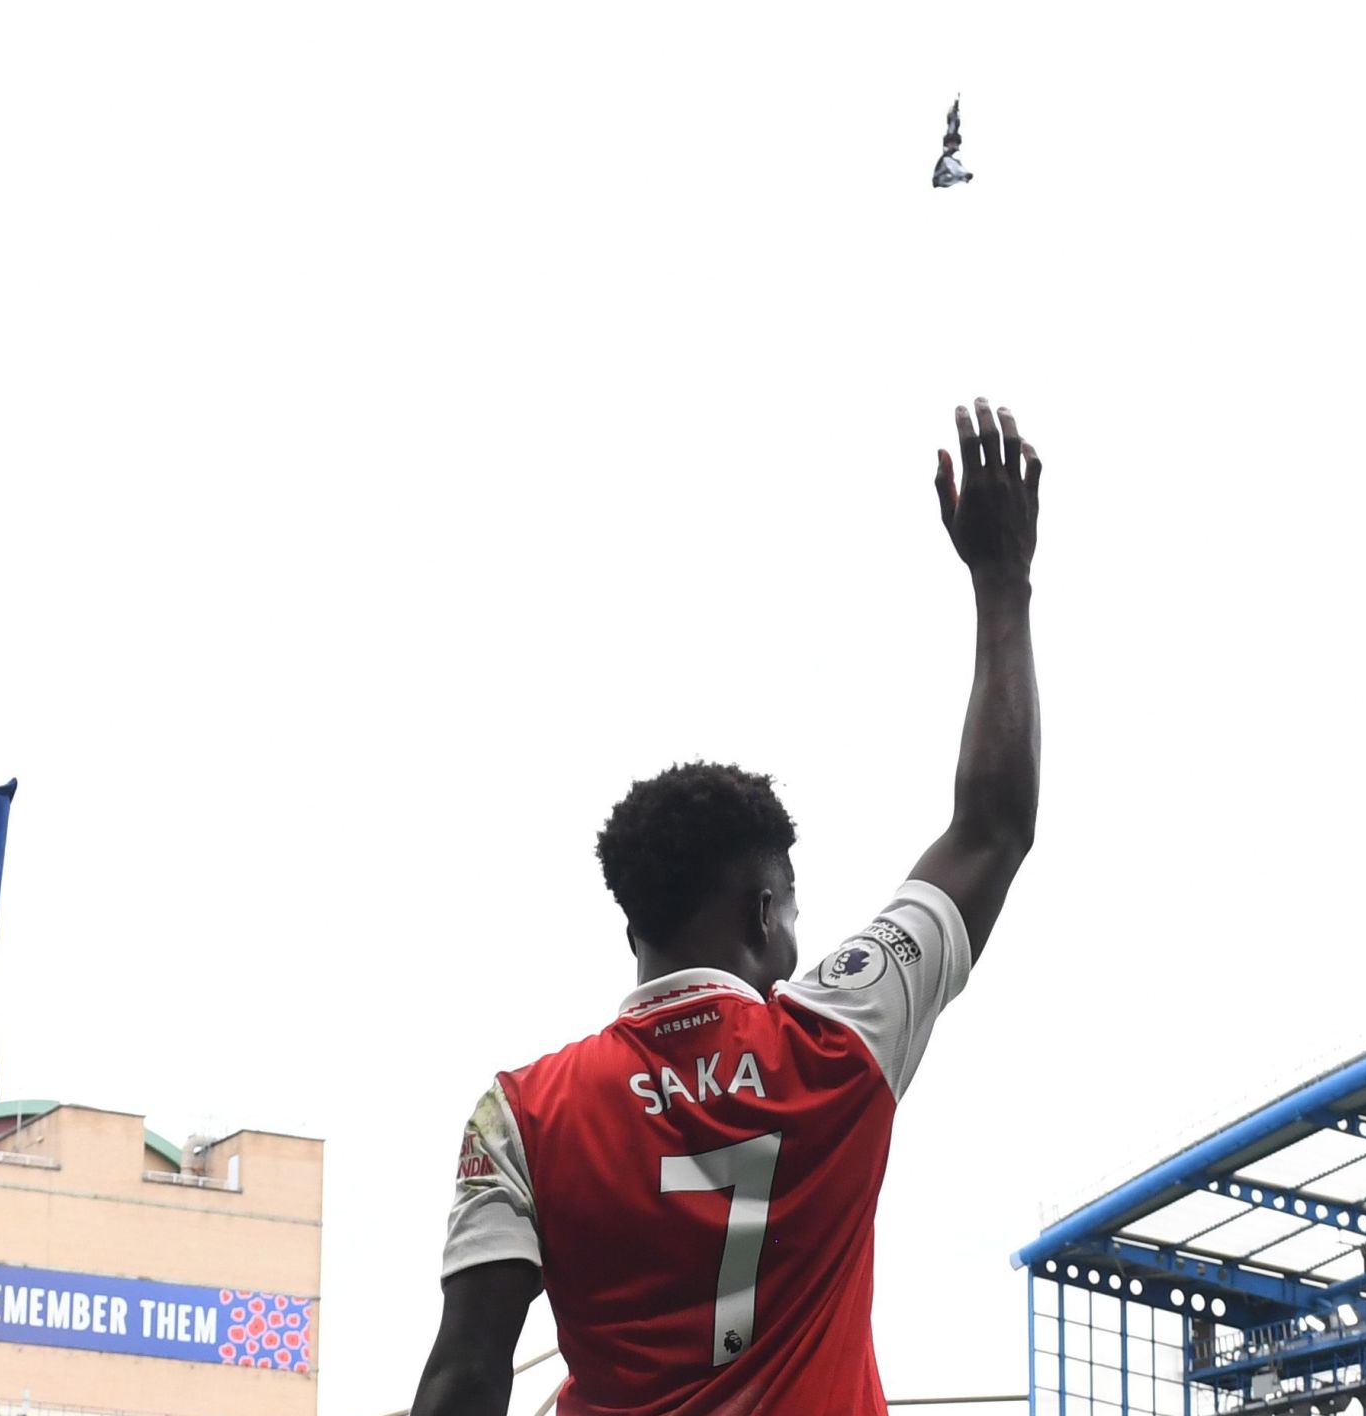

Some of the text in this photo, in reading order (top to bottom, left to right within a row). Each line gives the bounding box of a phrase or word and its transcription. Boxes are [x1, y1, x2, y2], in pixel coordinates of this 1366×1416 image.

[654, 1011, 720, 1037] ARSENAL
[629, 1051, 767, 1116] SAKA
[659, 1130, 783, 1368] 7
[139, 1299, 218, 1345] THEM
